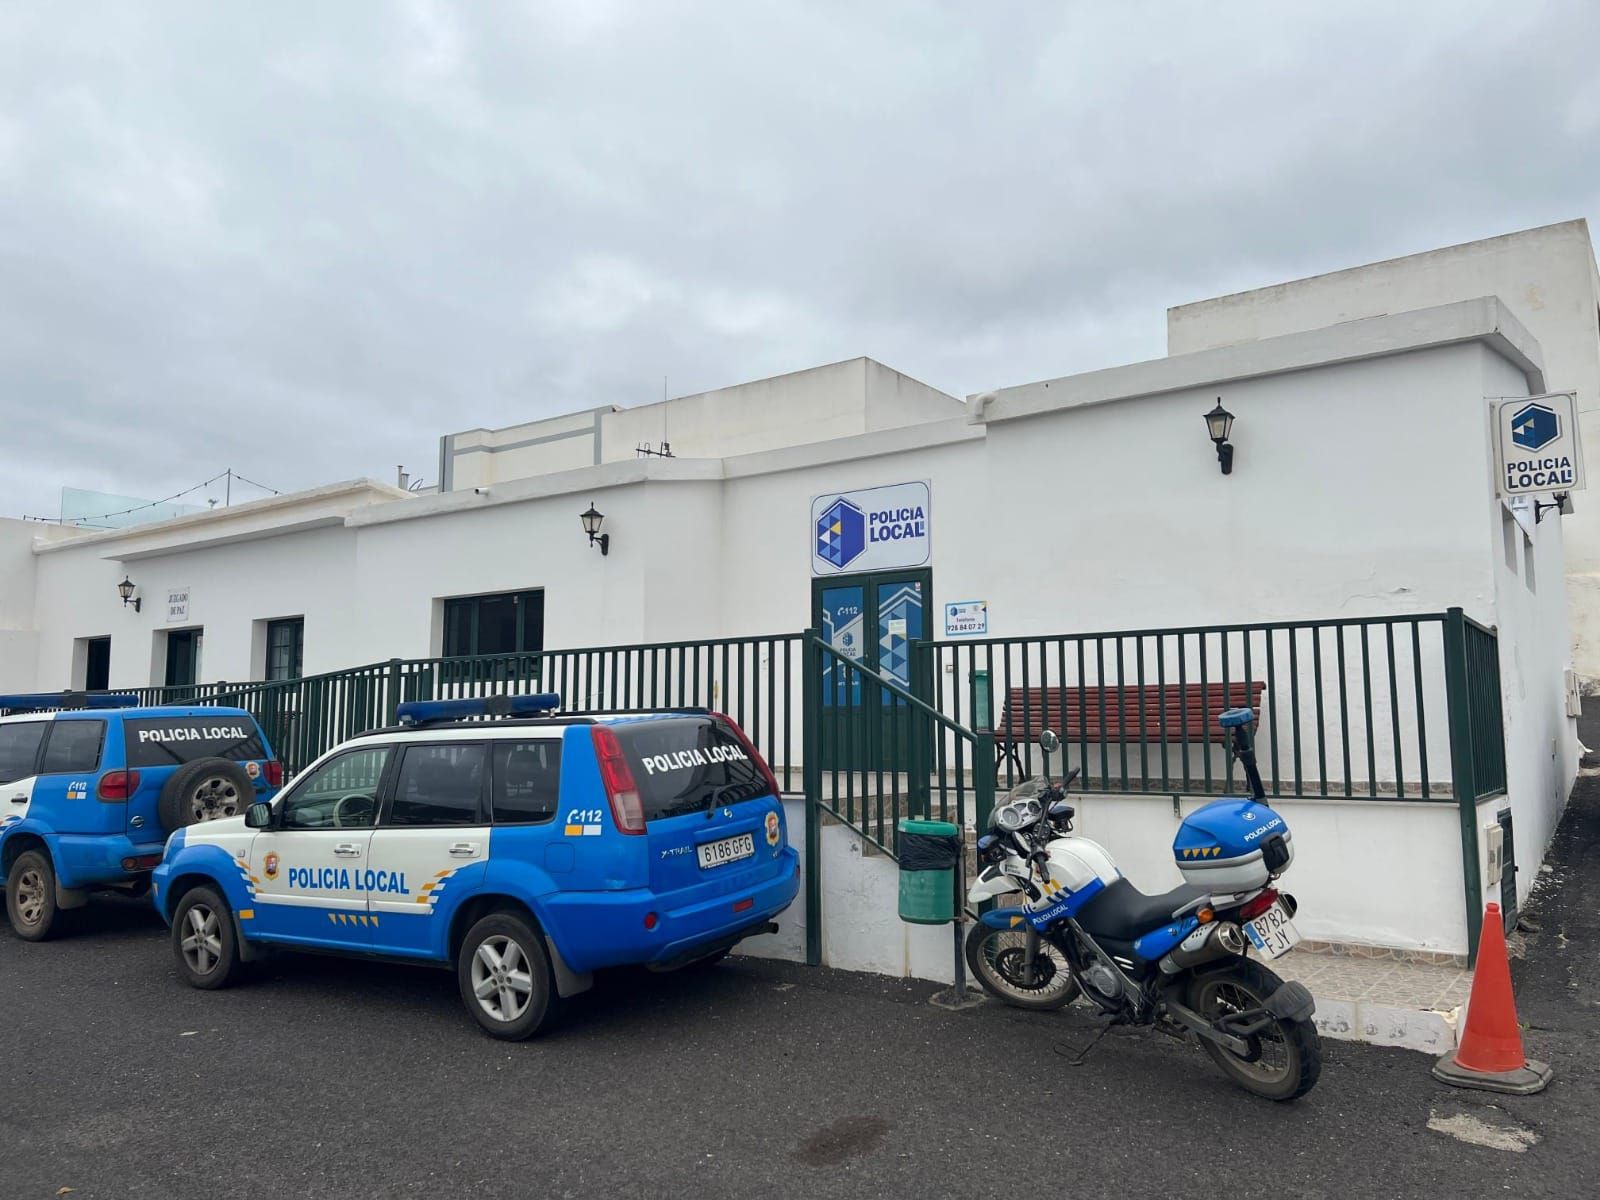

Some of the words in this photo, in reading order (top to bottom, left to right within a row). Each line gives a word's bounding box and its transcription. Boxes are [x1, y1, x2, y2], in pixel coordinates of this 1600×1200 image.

[1507, 457, 1571, 474] POLICIA
[1508, 469, 1572, 489] LOCAL
[869, 506, 924, 525] POLICIA
[870, 522, 925, 542] LOCAL
[139, 728, 201, 742] POLICIA
[203, 727, 248, 740] LOCAL
[641, 751, 705, 775] POLICIA
[704, 744, 748, 763] LOCAL
[1244, 825, 1268, 842] POLICIA
[704, 842, 731, 862] 6186
[732, 836, 752, 854] GFG
[289, 868, 350, 889] POLICIA
[355, 869, 410, 895] LOCAL
[1254, 908, 1288, 937] 8782
[1264, 928, 1291, 954] FJY
